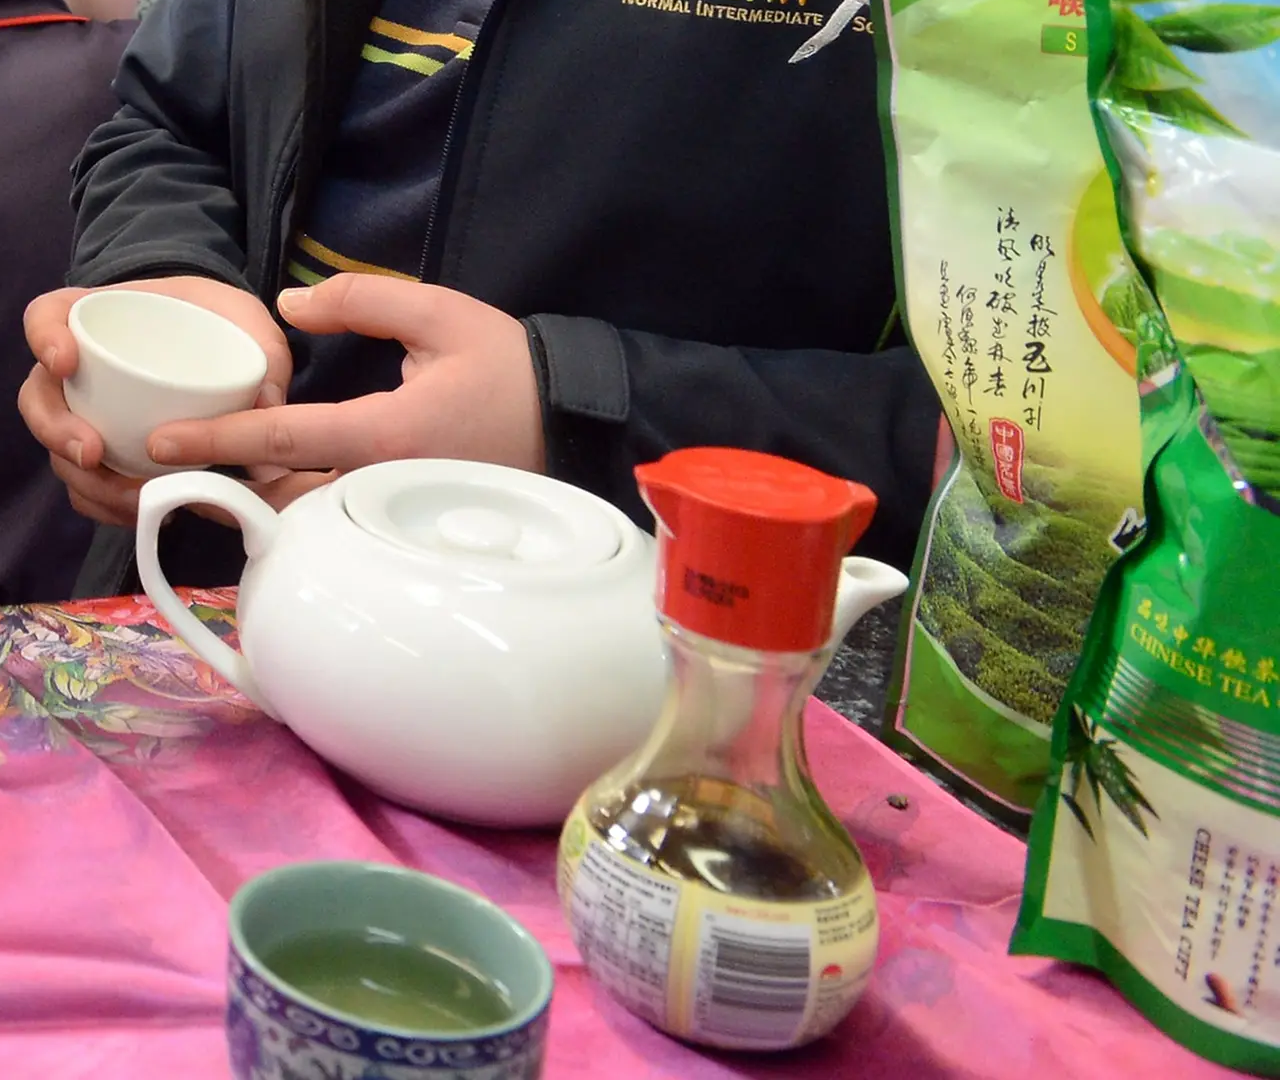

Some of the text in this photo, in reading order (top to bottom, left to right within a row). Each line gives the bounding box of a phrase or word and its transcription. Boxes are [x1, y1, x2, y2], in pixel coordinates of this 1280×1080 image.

[695, 0, 824, 28] INTERMEDIATE
[1130, 623, 1270, 709] CHINESE TEA
